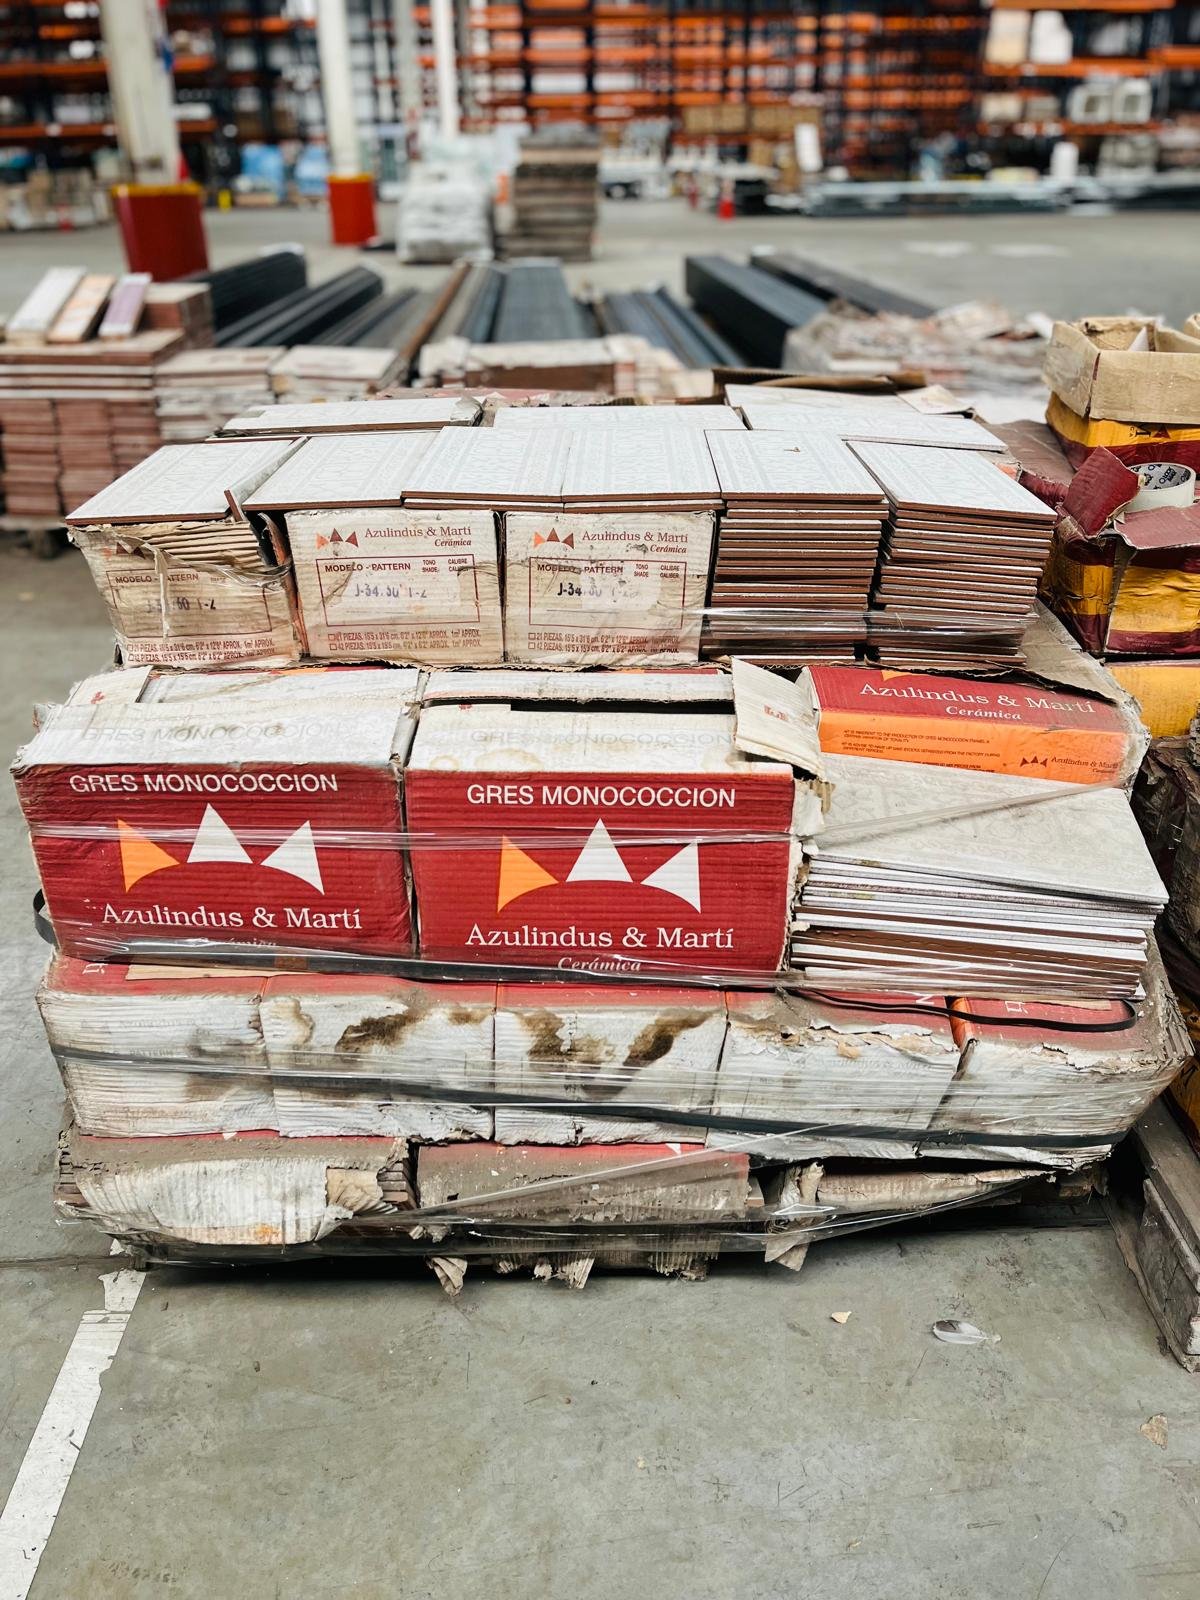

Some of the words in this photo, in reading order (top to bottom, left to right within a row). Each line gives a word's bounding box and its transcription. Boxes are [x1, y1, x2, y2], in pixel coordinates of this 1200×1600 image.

[364, 527, 424, 538] Azulindus
[426, 526, 437, 537] &
[582, 530, 641, 542] Azulindus
[643, 531, 654, 541] &
[434, 538, 472, 548] Cerámica
[649, 544, 688, 554] Cerámica
[324, 563, 364, 573] MODELO
[371, 562, 412, 571] PATTERN
[584, 565, 624, 574] PATTERN
[115, 574, 153, 584] MODELO
[859, 682, 990, 706] Azulindus
[997, 694, 1021, 708] &
[1024, 696, 1097, 714] Martí
[944, 706, 1022, 721] Cerámica
[69, 774, 138, 794] GRES
[143, 773, 339, 793] MONOCOCCION
[466, 784, 534, 805] GRES
[541, 786, 736, 807] MONOCOCCION
[101, 903, 244, 927] Azulindus
[252, 907, 277, 928] &
[283, 907, 362, 930] Martí
[464, 923, 613, 948] Azulindus
[621, 926, 647, 948] &
[656, 928, 734, 949] Martí
[557, 957, 642, 972] Cerámica
